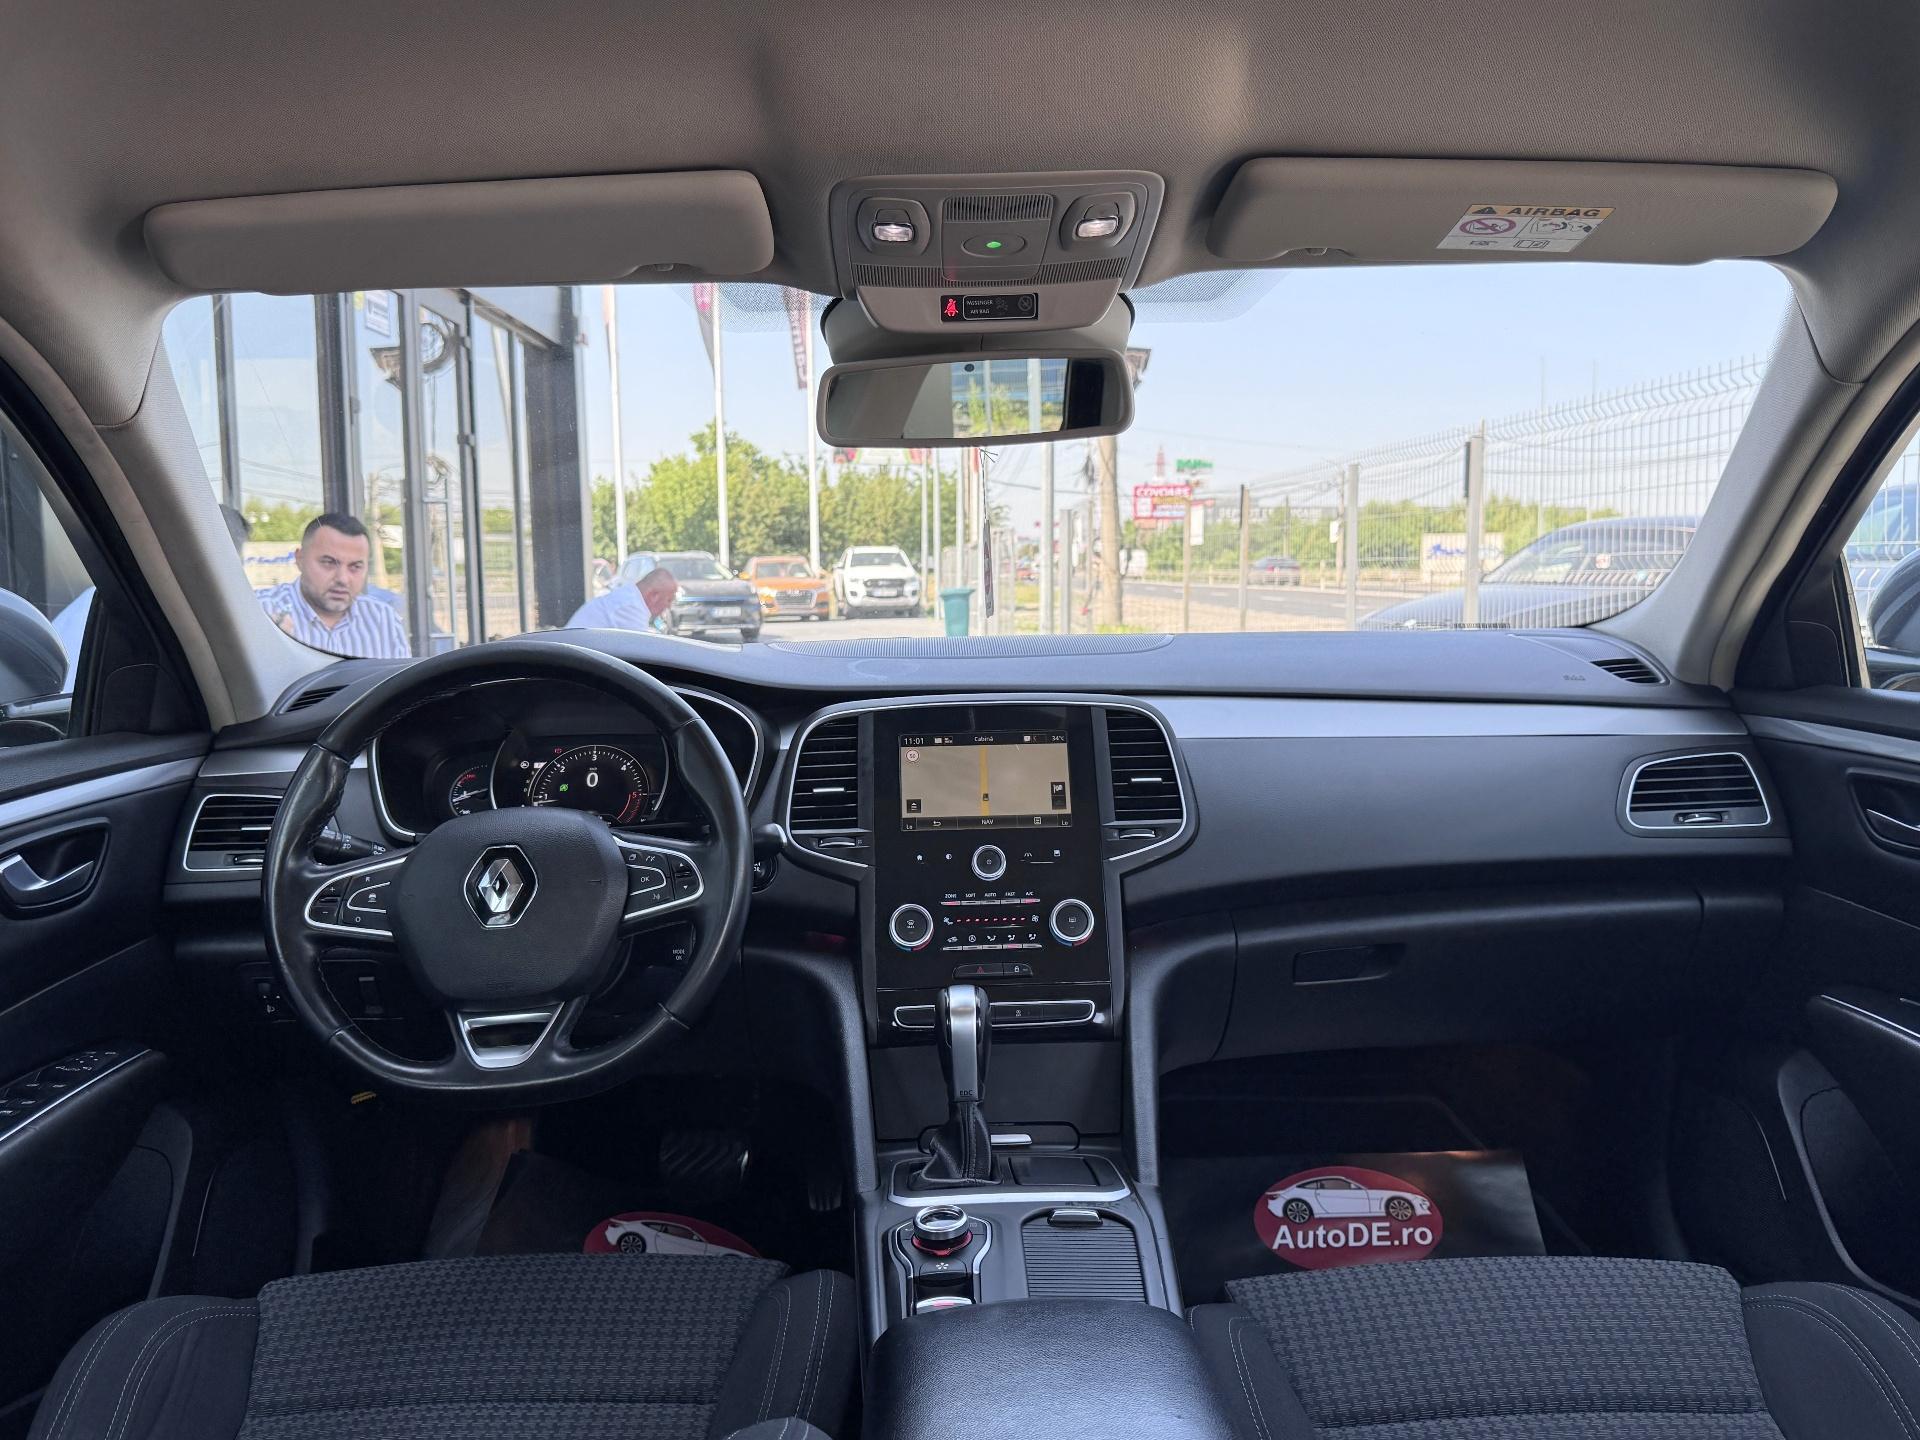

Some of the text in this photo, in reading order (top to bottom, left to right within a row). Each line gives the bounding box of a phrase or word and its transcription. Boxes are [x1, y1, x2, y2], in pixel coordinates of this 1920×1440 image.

[1507, 206, 1600, 217] AIRBAG
[904, 737, 924, 745] 11:01
[586, 772, 599, 788] 0
[1272, 1222, 1433, 1250] AutoDE.ro
